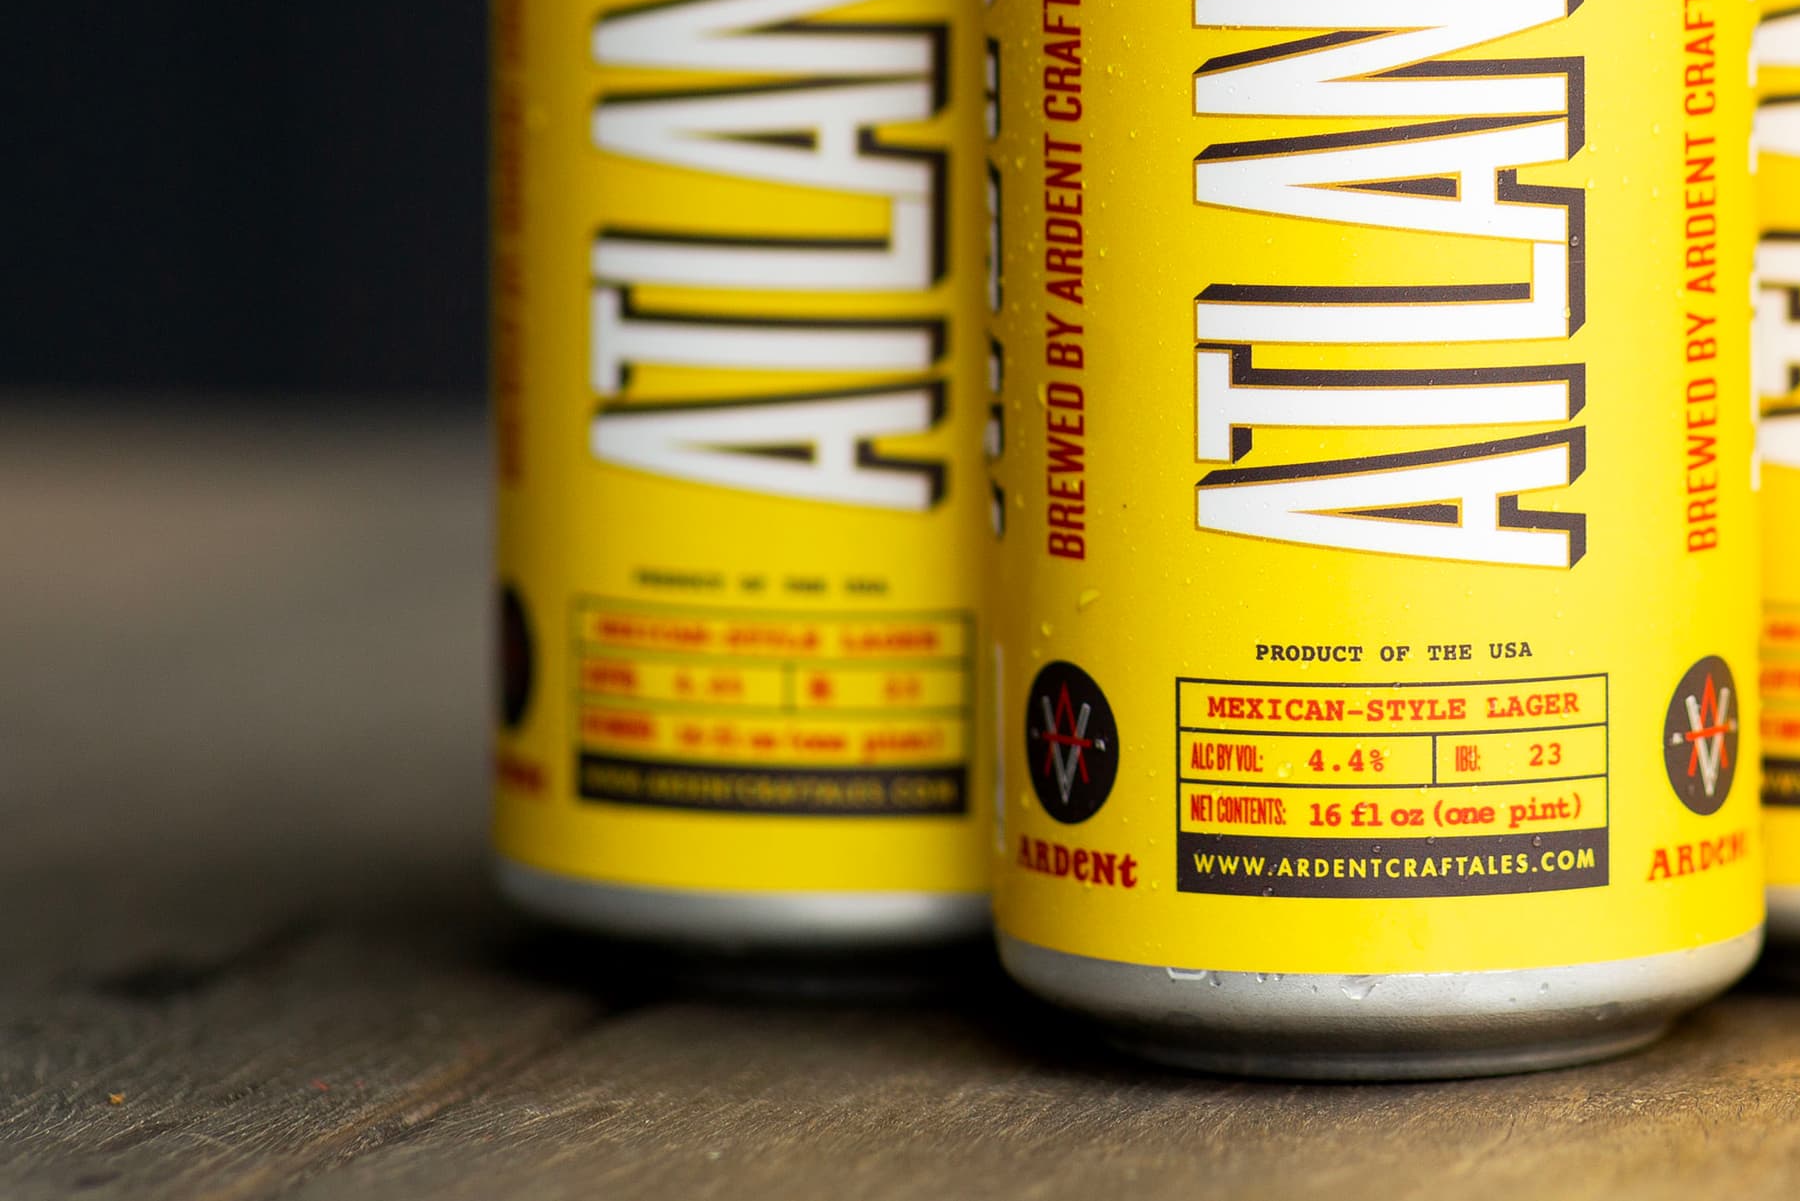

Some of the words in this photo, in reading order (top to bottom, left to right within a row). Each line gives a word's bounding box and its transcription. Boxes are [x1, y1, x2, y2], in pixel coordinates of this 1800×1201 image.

[1044, 133, 1085, 307] ARDENT
[1685, 131, 1717, 295] ARDENT
[1046, 313, 1086, 370] BY
[1685, 311, 1718, 364] BY
[1046, 381, 1086, 561] BREWED
[1686, 376, 1718, 555] BREWED
[1255, 643, 1363, 663] PRODUCT
[1380, 645, 1410, 662] OF
[1427, 643, 1472, 661] THE
[1490, 642, 1533, 659] USA
[1207, 695, 1466, 722] MEXICAN-STYLE
[1487, 692, 1580, 719] LAGER
[1191, 742, 1215, 770] ALC
[1216, 743, 1236, 771] BY
[1235, 744, 1264, 773] VOL:
[1308, 749, 1384, 773] 4.4%
[1528, 743, 1562, 767] 23
[1191, 794, 1214, 822] NET
[1216, 796, 1287, 826] CONTENTS:
[1309, 803, 1341, 827] 16
[1350, 801, 1383, 827] fl
[1390, 807, 1425, 827] oz
[1433, 799, 1495, 828] (one
[1509, 792, 1582, 828] pint)
[1193, 847, 1596, 879] WWW.ARDENTCRAFTALES.COM
